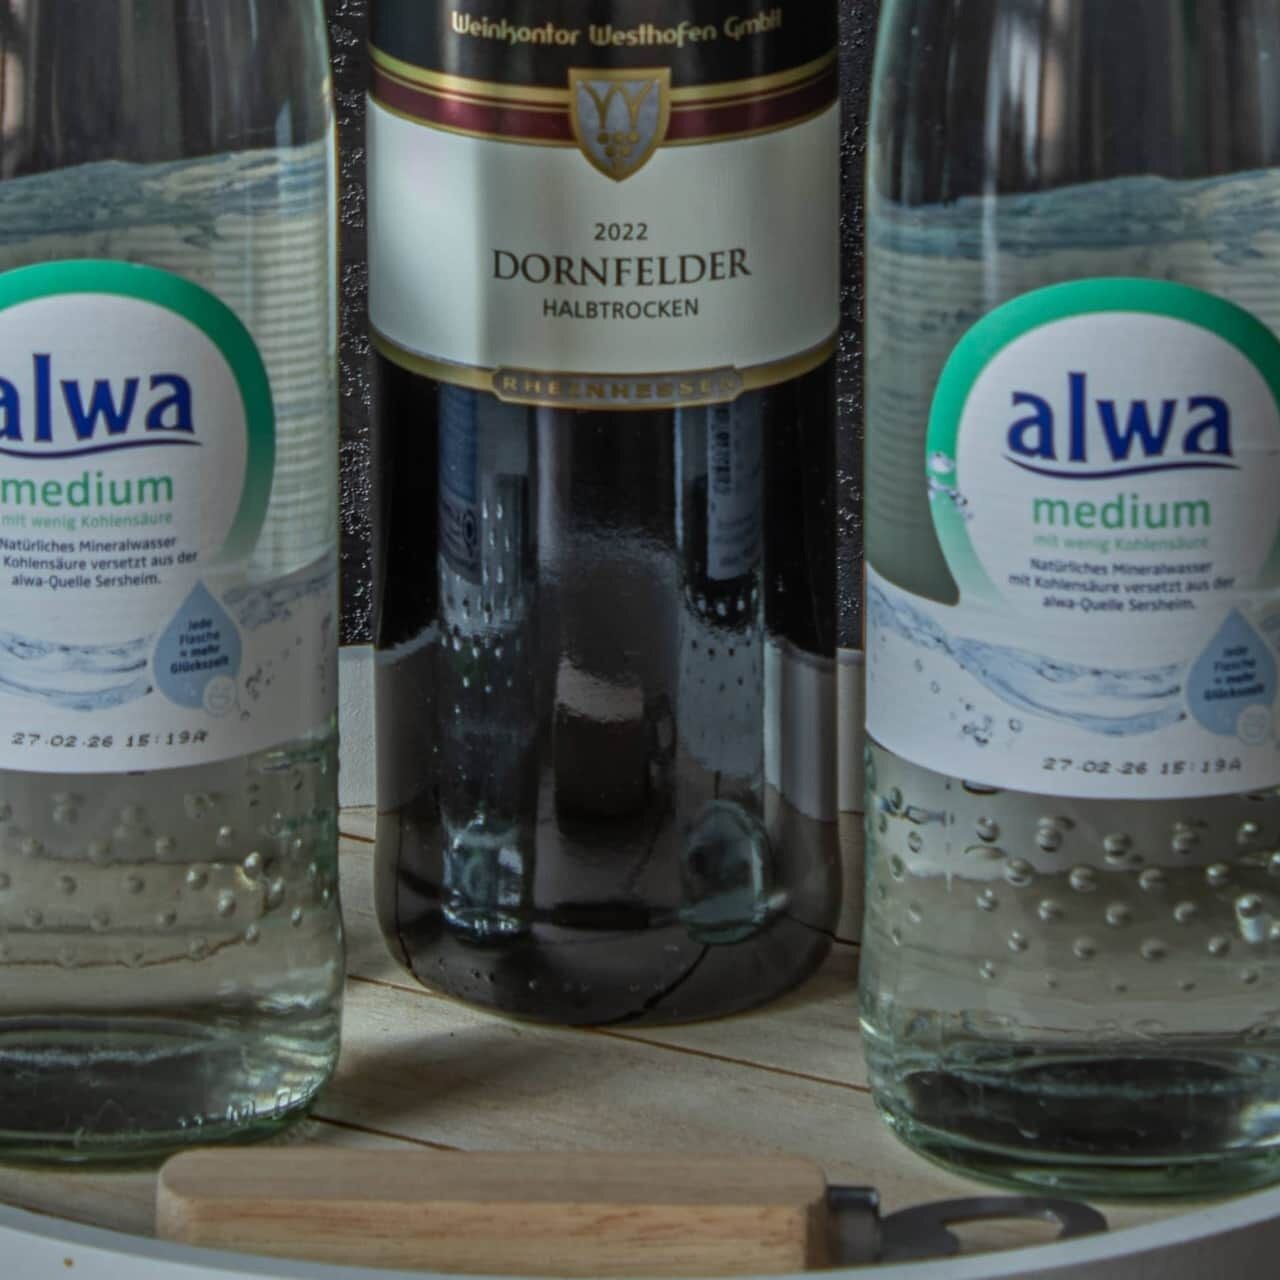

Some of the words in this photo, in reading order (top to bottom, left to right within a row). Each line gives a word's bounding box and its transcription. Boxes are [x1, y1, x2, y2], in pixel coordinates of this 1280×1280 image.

[451, 10, 581, 46] Weinkontor
[589, 22, 718, 48] Westhofen
[724, 7, 784, 41] GmbH
[593, 222, 649, 241] 2022
[492, 247, 752, 287] DORNFELDER
[543, 298, 700, 320] HALBTROCKEN
[1007, 372, 1233, 463] alwa
[0, 471, 174, 507] medium
[1032, 493, 1211, 529] medium
[1, 515, 27, 528] mit
[31, 516, 76, 531] wenig
[81, 512, 173, 530] Kohlensäure
[0, 538, 75, 553] Natürliches
[79, 536, 177, 553] Mineralwasser
[3, 556, 87, 571] Kohlensäure
[91, 556, 148, 571] versetzt
[151, 553, 174, 567] aus
[177, 551, 198, 564] der
[1029, 558, 1108, 575] Natürliches
[1113, 561, 1213, 576] Mineralwasser
[11, 574, 91, 591] alwa-Quelle
[95, 573, 161, 589] Sersheim.
[1008, 574, 1031, 588] mit
[1034, 575, 1120, 593] Kohlensäure
[1124, 579, 1182, 594] versetzt
[1186, 579, 1210, 592] aus
[1043, 596, 1124, 613] alwa-Quelle
